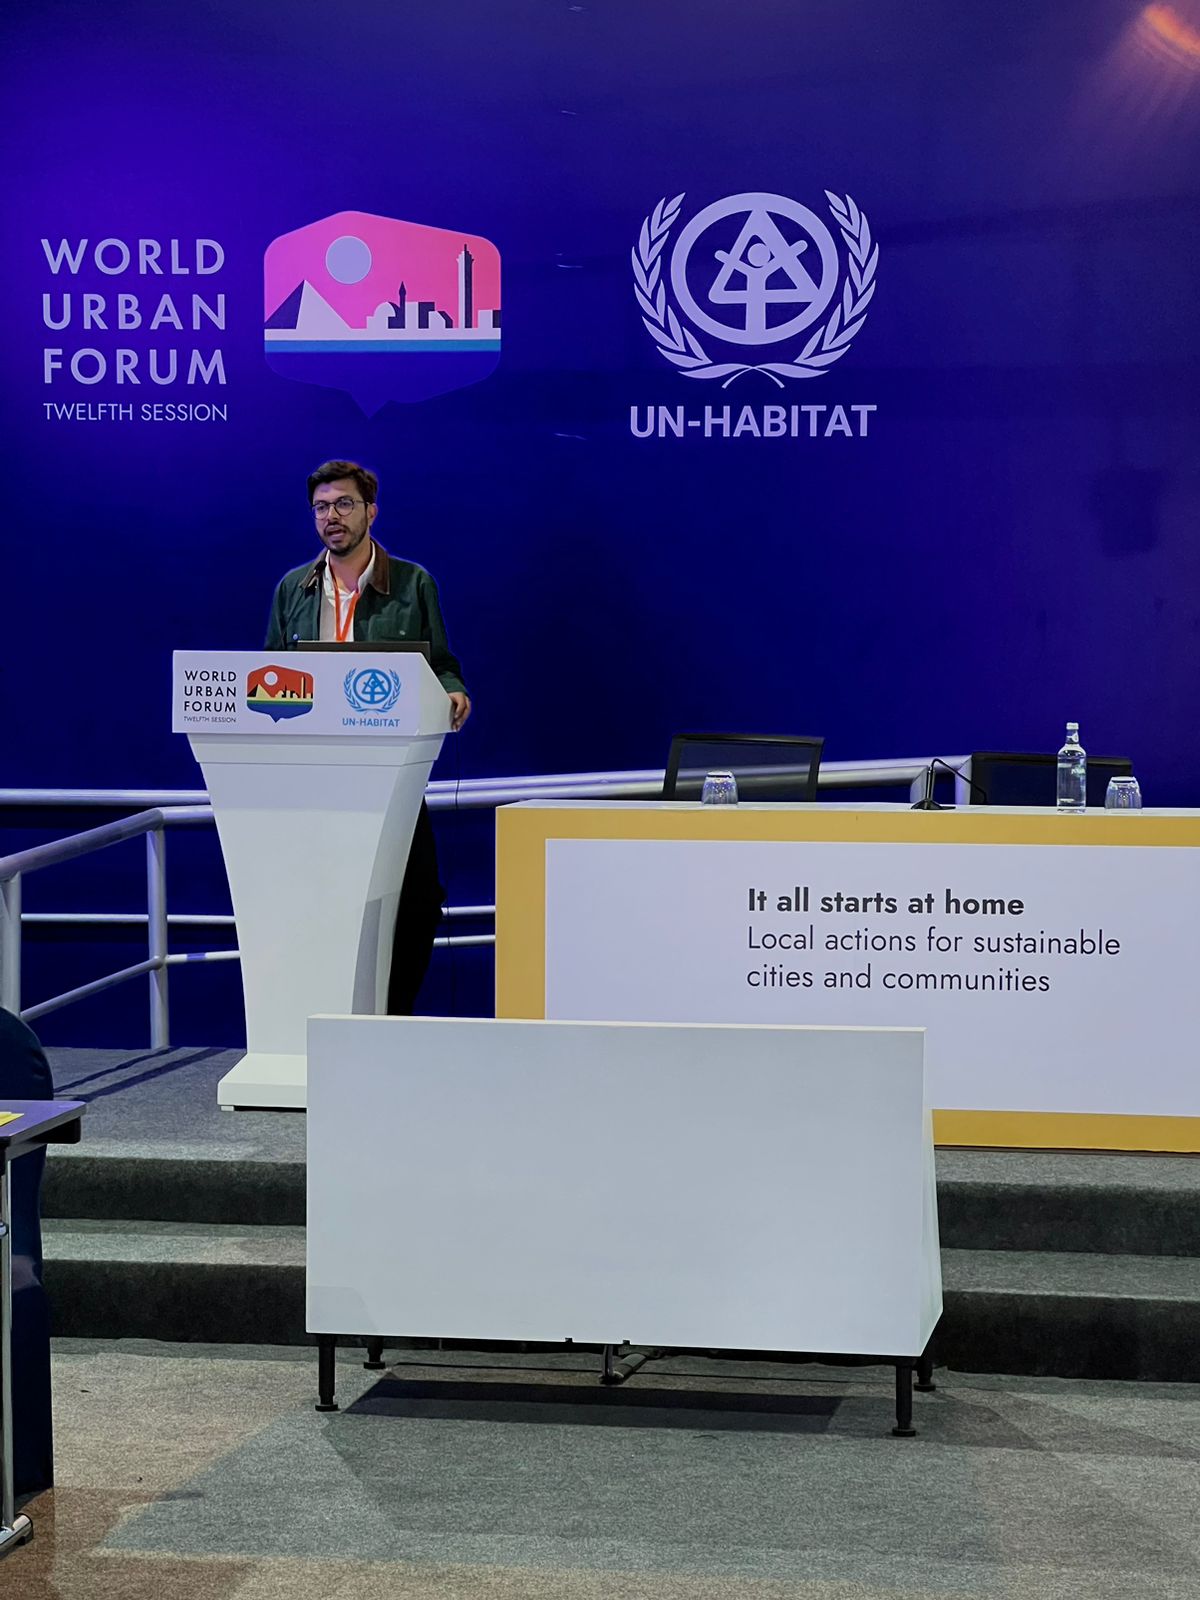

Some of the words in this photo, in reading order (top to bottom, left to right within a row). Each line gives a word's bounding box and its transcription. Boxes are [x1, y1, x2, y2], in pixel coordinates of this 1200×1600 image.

[41, 238, 225, 275] WORLD
[42, 293, 226, 330] URBAN
[44, 348, 227, 385] FORUM
[43, 403, 134, 421] TWELFTH
[140, 404, 228, 422] SESSION
[630, 404, 878, 438] UN-HABITAT
[184, 670, 237, 682] WORLD
[184, 686, 237, 697] URBAN
[183, 701, 237, 713] FORUM
[342, 718, 401, 728] UN-HABITAT
[748, 888, 767, 911] It
[776, 886, 810, 912] all
[820, 891, 898, 914] starts
[908, 893, 935, 914] at
[945, 888, 1025, 916] home
[748, 924, 815, 950] Local
[825, 927, 917, 952] actions
[927, 926, 963, 952] for
[973, 929, 1121, 955] sustainable
[746, 963, 814, 988] cities
[823, 963, 872, 989] and
[882, 967, 1050, 992] communities
